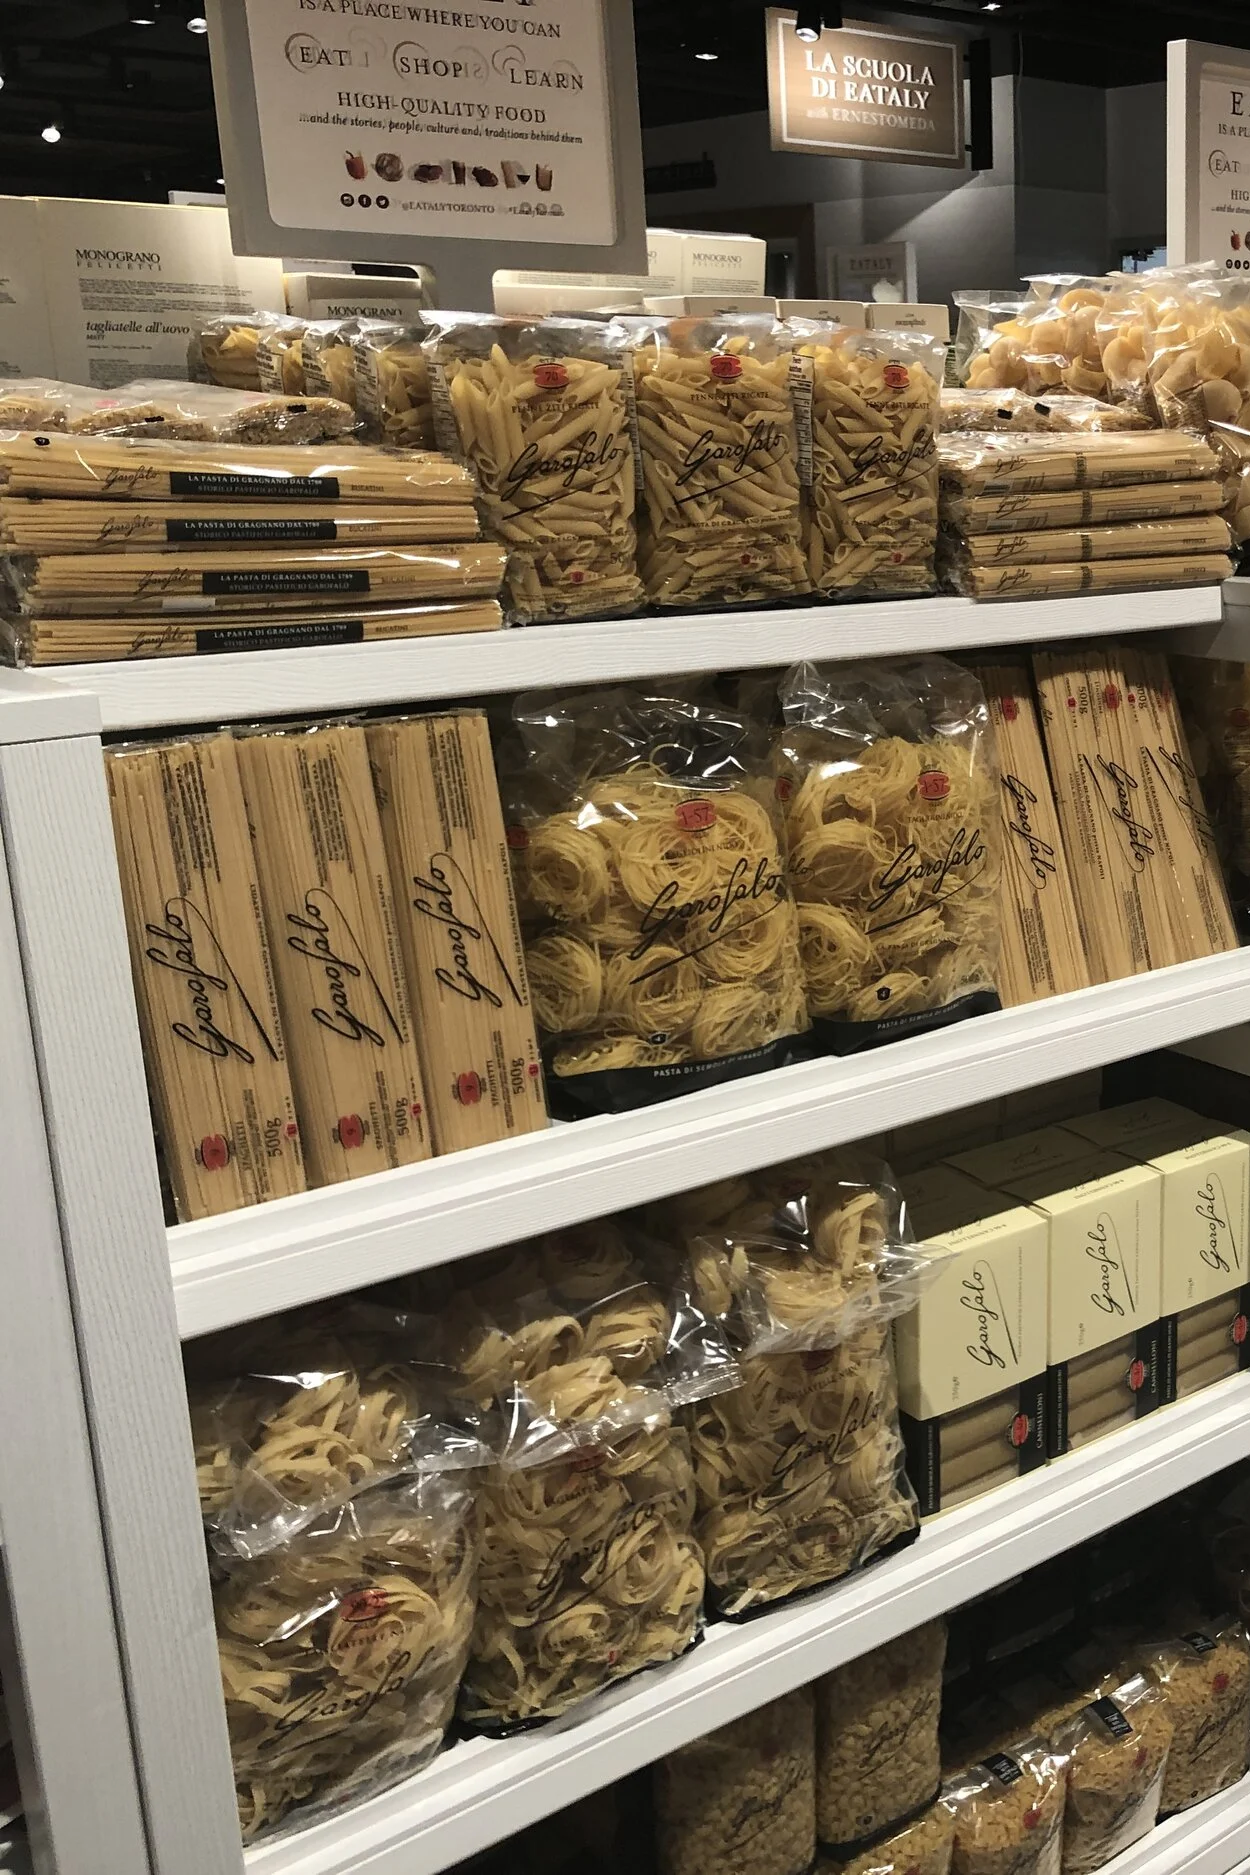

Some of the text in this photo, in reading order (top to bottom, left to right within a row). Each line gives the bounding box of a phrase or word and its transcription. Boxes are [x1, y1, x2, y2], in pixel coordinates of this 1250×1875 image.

[300, 0, 561, 39] IS A PLACE WHERE YOU CAN
[299, 46, 584, 91] EAT SHOP LEARN
[804, 49, 936, 87] LA SCUOLA
[337, 91, 546, 124] HIGH-QUALITY FOOD
[810, 76, 931, 110] DI EATALY
[332, 113, 583, 144] the stories, people, culture and, traditions behind them
[832, 107, 936, 132] ERNESTOMEDA
[1218, 123, 1227, 136] IS
[1229, 125, 1237, 136] A
[1214, 158, 1241, 174] EAT
[1226, 204, 1235, 214] the
[75, 248, 162, 264] MONOGRANO
[76, 261, 162, 272] FELICETTI
[692, 251, 742, 264] MONOGRANO
[849, 256, 893, 272] EATALY
[86, 319, 191, 337] tagliatelle all'uovo
[500, 430, 623, 500] Garofalo
[675, 419, 784, 487] Garofalo
[845, 425, 937, 485] Garofalo
[104, 466, 159, 491] Garofalo
[200, 475, 228, 484] PASTA
[229, 476, 240, 484] DI
[242, 476, 288, 485] GRAGNANO
[288, 477, 306, 485] DAL
[97, 514, 155, 541] Garofalo
[197, 522, 226, 530] PASTA
[226, 522, 238, 530] DI
[238, 522, 286, 530] GRAGNANO
[287, 521, 302, 529] DAL
[134, 567, 190, 596] Garofalo
[232, 574, 260, 582] PASTA
[261, 574, 272, 582] DI
[272, 573, 318, 582] GRAGNANO
[318, 573, 336, 581] DAL
[129, 626, 184, 653] Garofalo
[226, 630, 253, 638] PASTA
[255, 629, 266, 637] DI
[266, 627, 312, 636] GRAGNANO
[1078, 685, 1089, 715] 500g
[1139, 745, 1146, 756] LA
[921, 777, 946, 794] 1-57
[1147, 776, 1153, 785] DI
[681, 806, 710, 822] 1-57
[1076, 753, 1105, 881] LA PASTA DI GRAGNANO NAPOLI
[1096, 753, 1155, 864] Garofalo
[1148, 785, 1162, 819] GRAGNANO
[1158, 745, 1215, 856] Garofalo
[1000, 773, 1056, 881] Garofalo
[499, 842, 510, 876] NAPOLI
[867, 827, 986, 913] Garofalo
[629, 857, 783, 961] Garofalo
[413, 864, 503, 1008] Garofalo
[508, 903, 521, 953] GRAGNANO
[145, 911, 255, 1065] Garofalo
[286, 899, 387, 1048] Garofalo
[517, 967, 528, 993] PASTA
[877, 1018, 908, 1030] PASTA DI
[510, 1057, 526, 1095] 500g
[653, 1061, 727, 1077] PASTA DI SEMOLA
[394, 1096, 410, 1137] 500g
[264, 1117, 283, 1158] 500g
[1195, 1181, 1231, 1274] Garofalo
[1085, 1221, 1125, 1317] Garofalo
[960, 1270, 1007, 1369] Garofalo
[1149, 1338, 1158, 1394] CANNELLONI
[1035, 1391, 1044, 1450] CANNELLONI
